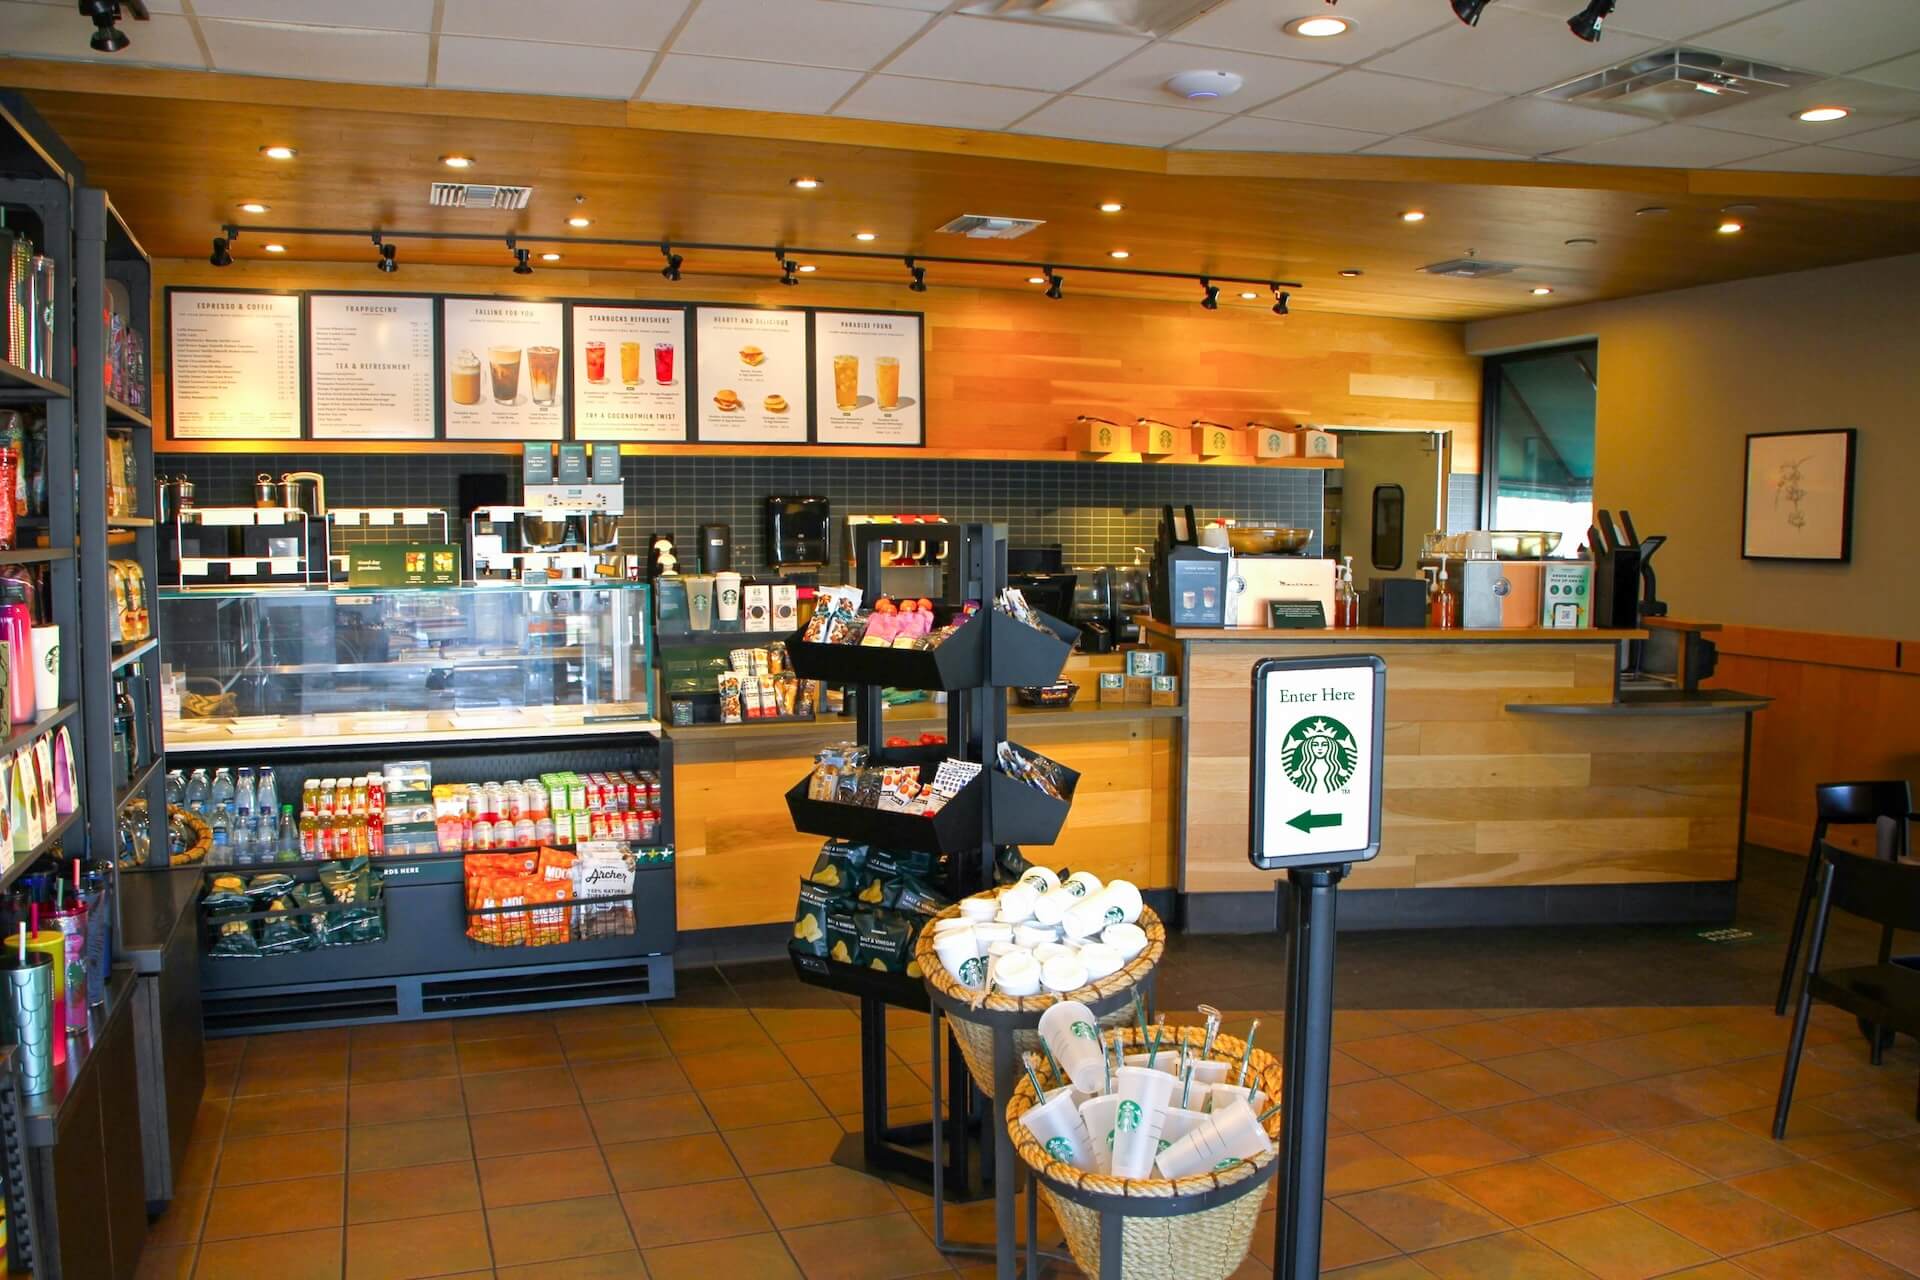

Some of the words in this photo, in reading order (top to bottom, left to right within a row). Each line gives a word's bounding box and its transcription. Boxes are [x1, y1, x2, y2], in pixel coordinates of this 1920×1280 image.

[505, 309, 517, 317] FOR
[840, 321, 871, 329] PARADISE
[1280, 688, 1318, 703] Enter
[1322, 688, 1356, 702] Here
[585, 868, 627, 884] Archer
